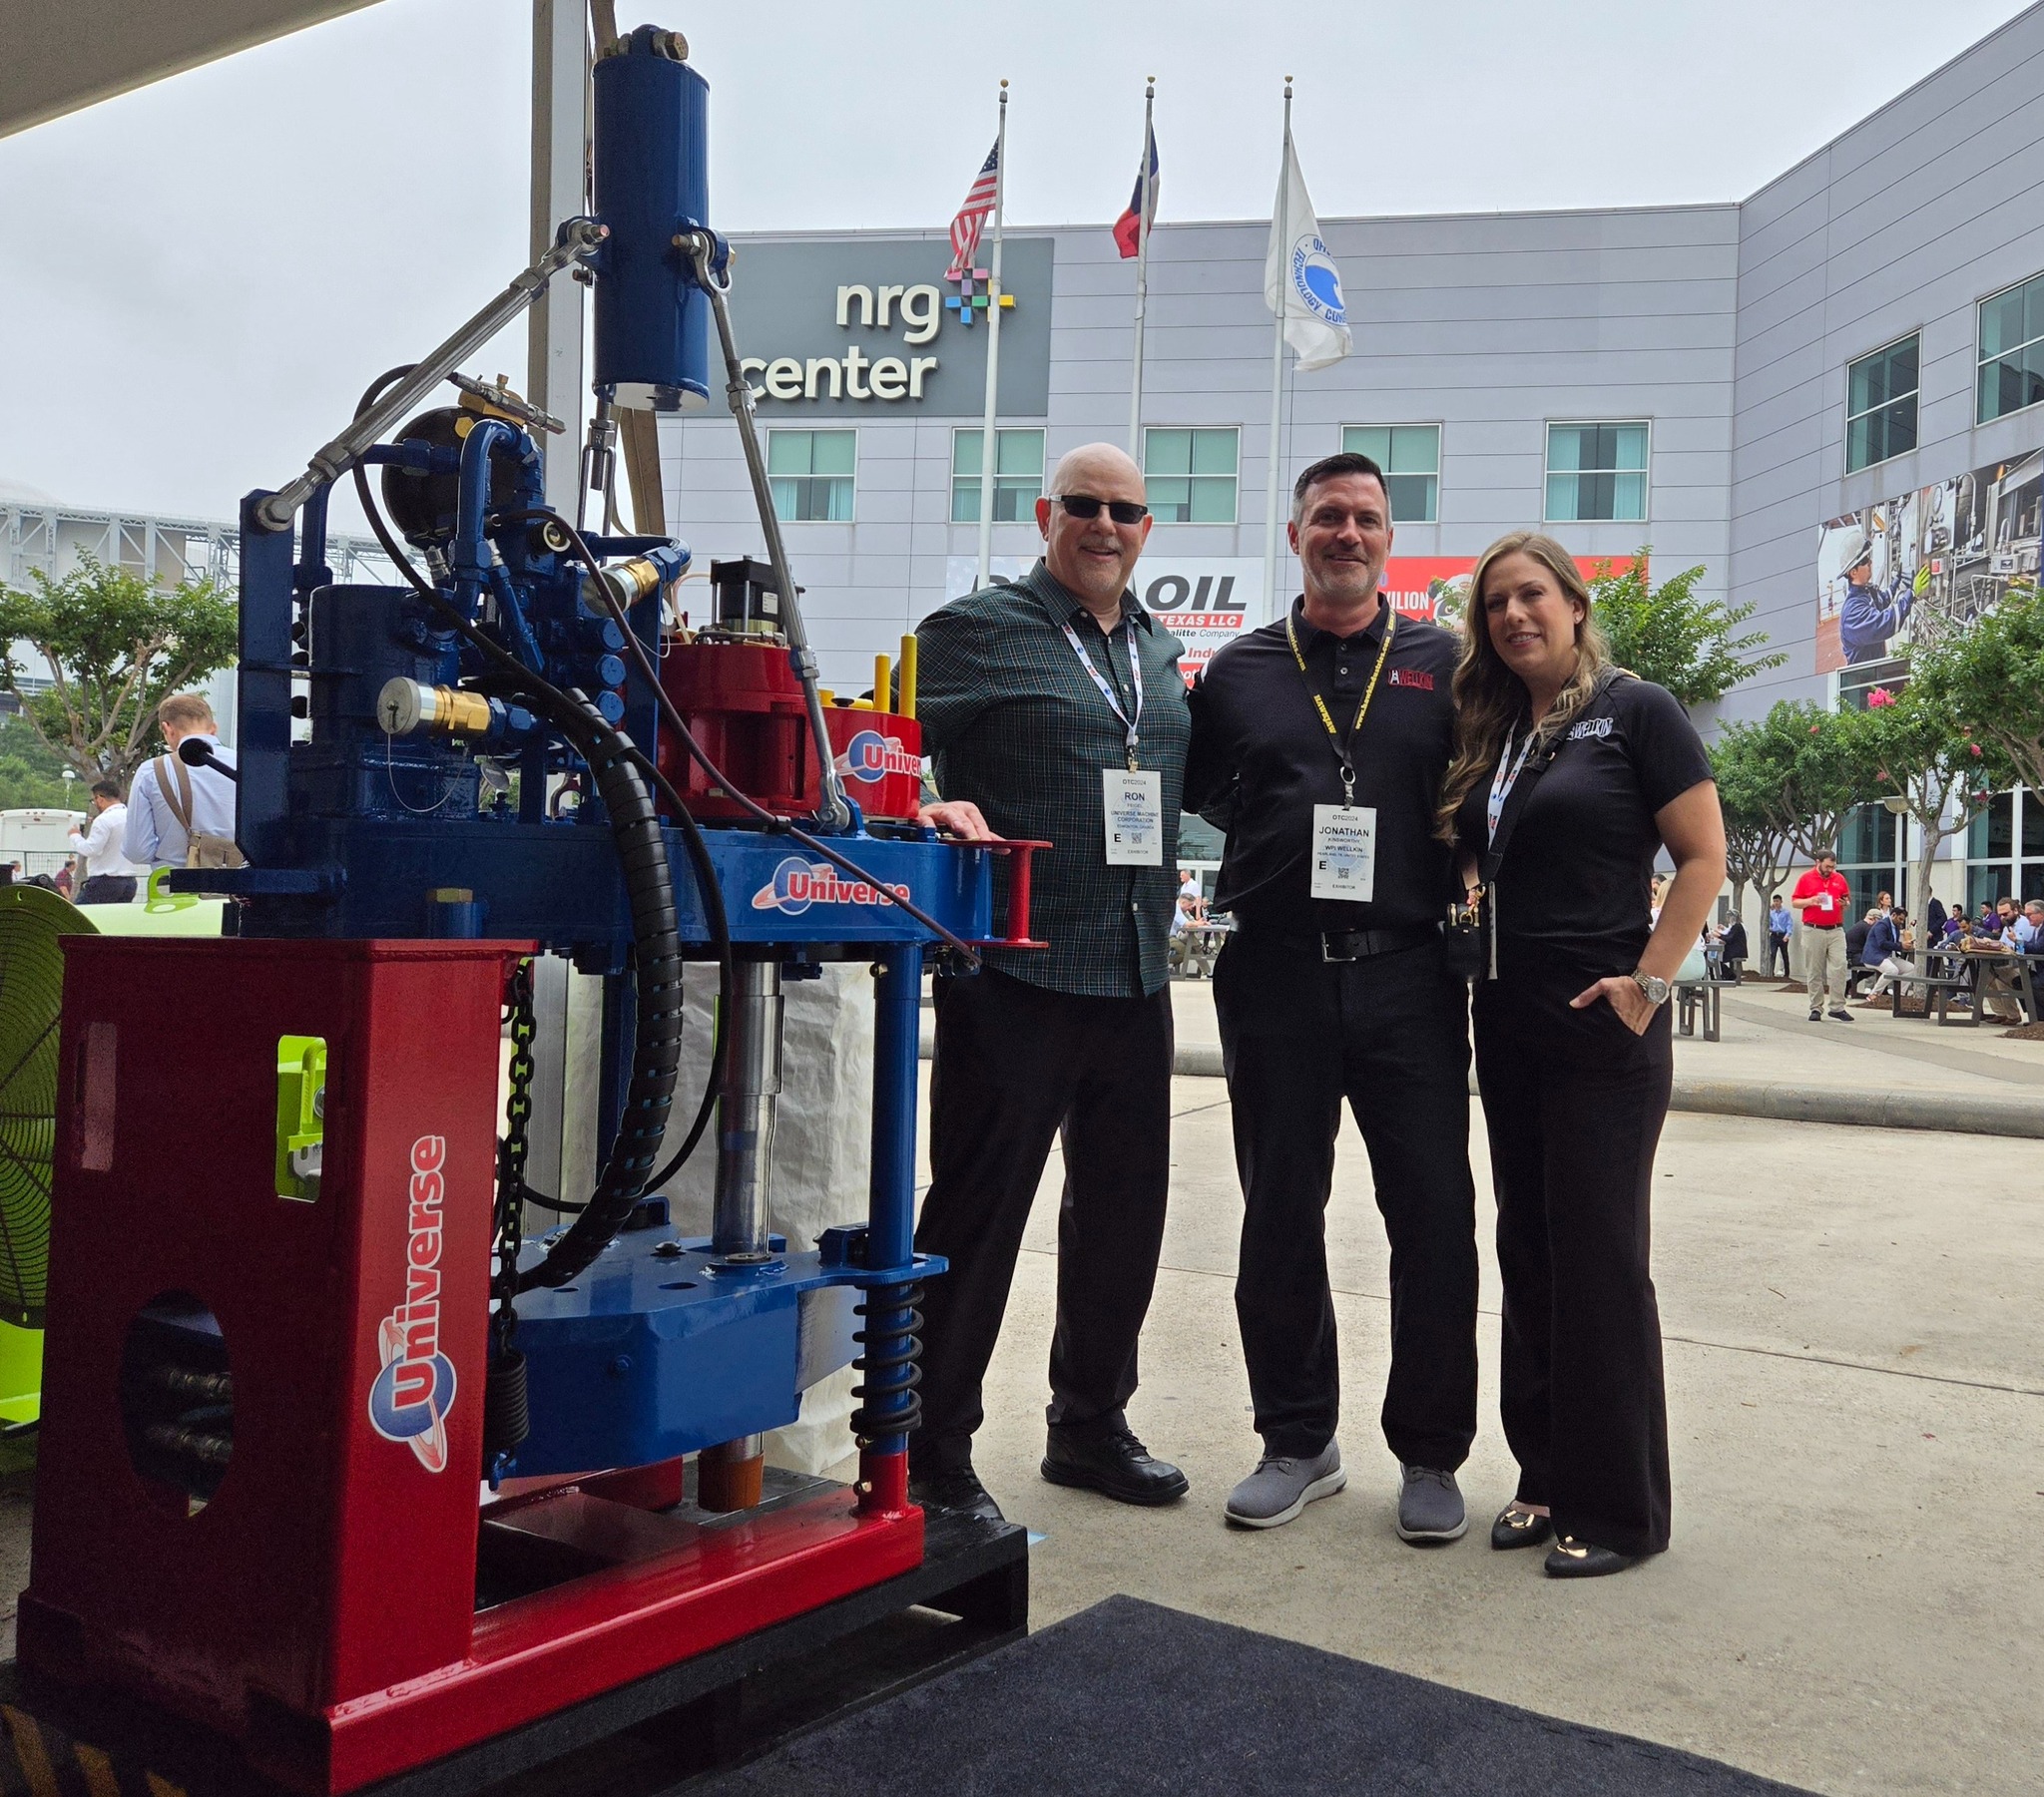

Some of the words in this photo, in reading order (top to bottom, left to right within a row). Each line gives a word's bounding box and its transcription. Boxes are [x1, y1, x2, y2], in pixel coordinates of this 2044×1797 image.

[835, 283, 941, 345] nrg
[741, 345, 938, 400] center
[1158, 615, 1205, 627] TEXAS
[1209, 615, 1238, 627] LLC
[1124, 791, 1145, 801] RON
[1318, 826, 1369, 837] JONATHAN
[1114, 833, 1122, 843] E
[1318, 860, 1327, 870] E
[392, 1135, 445, 1411] Universe
